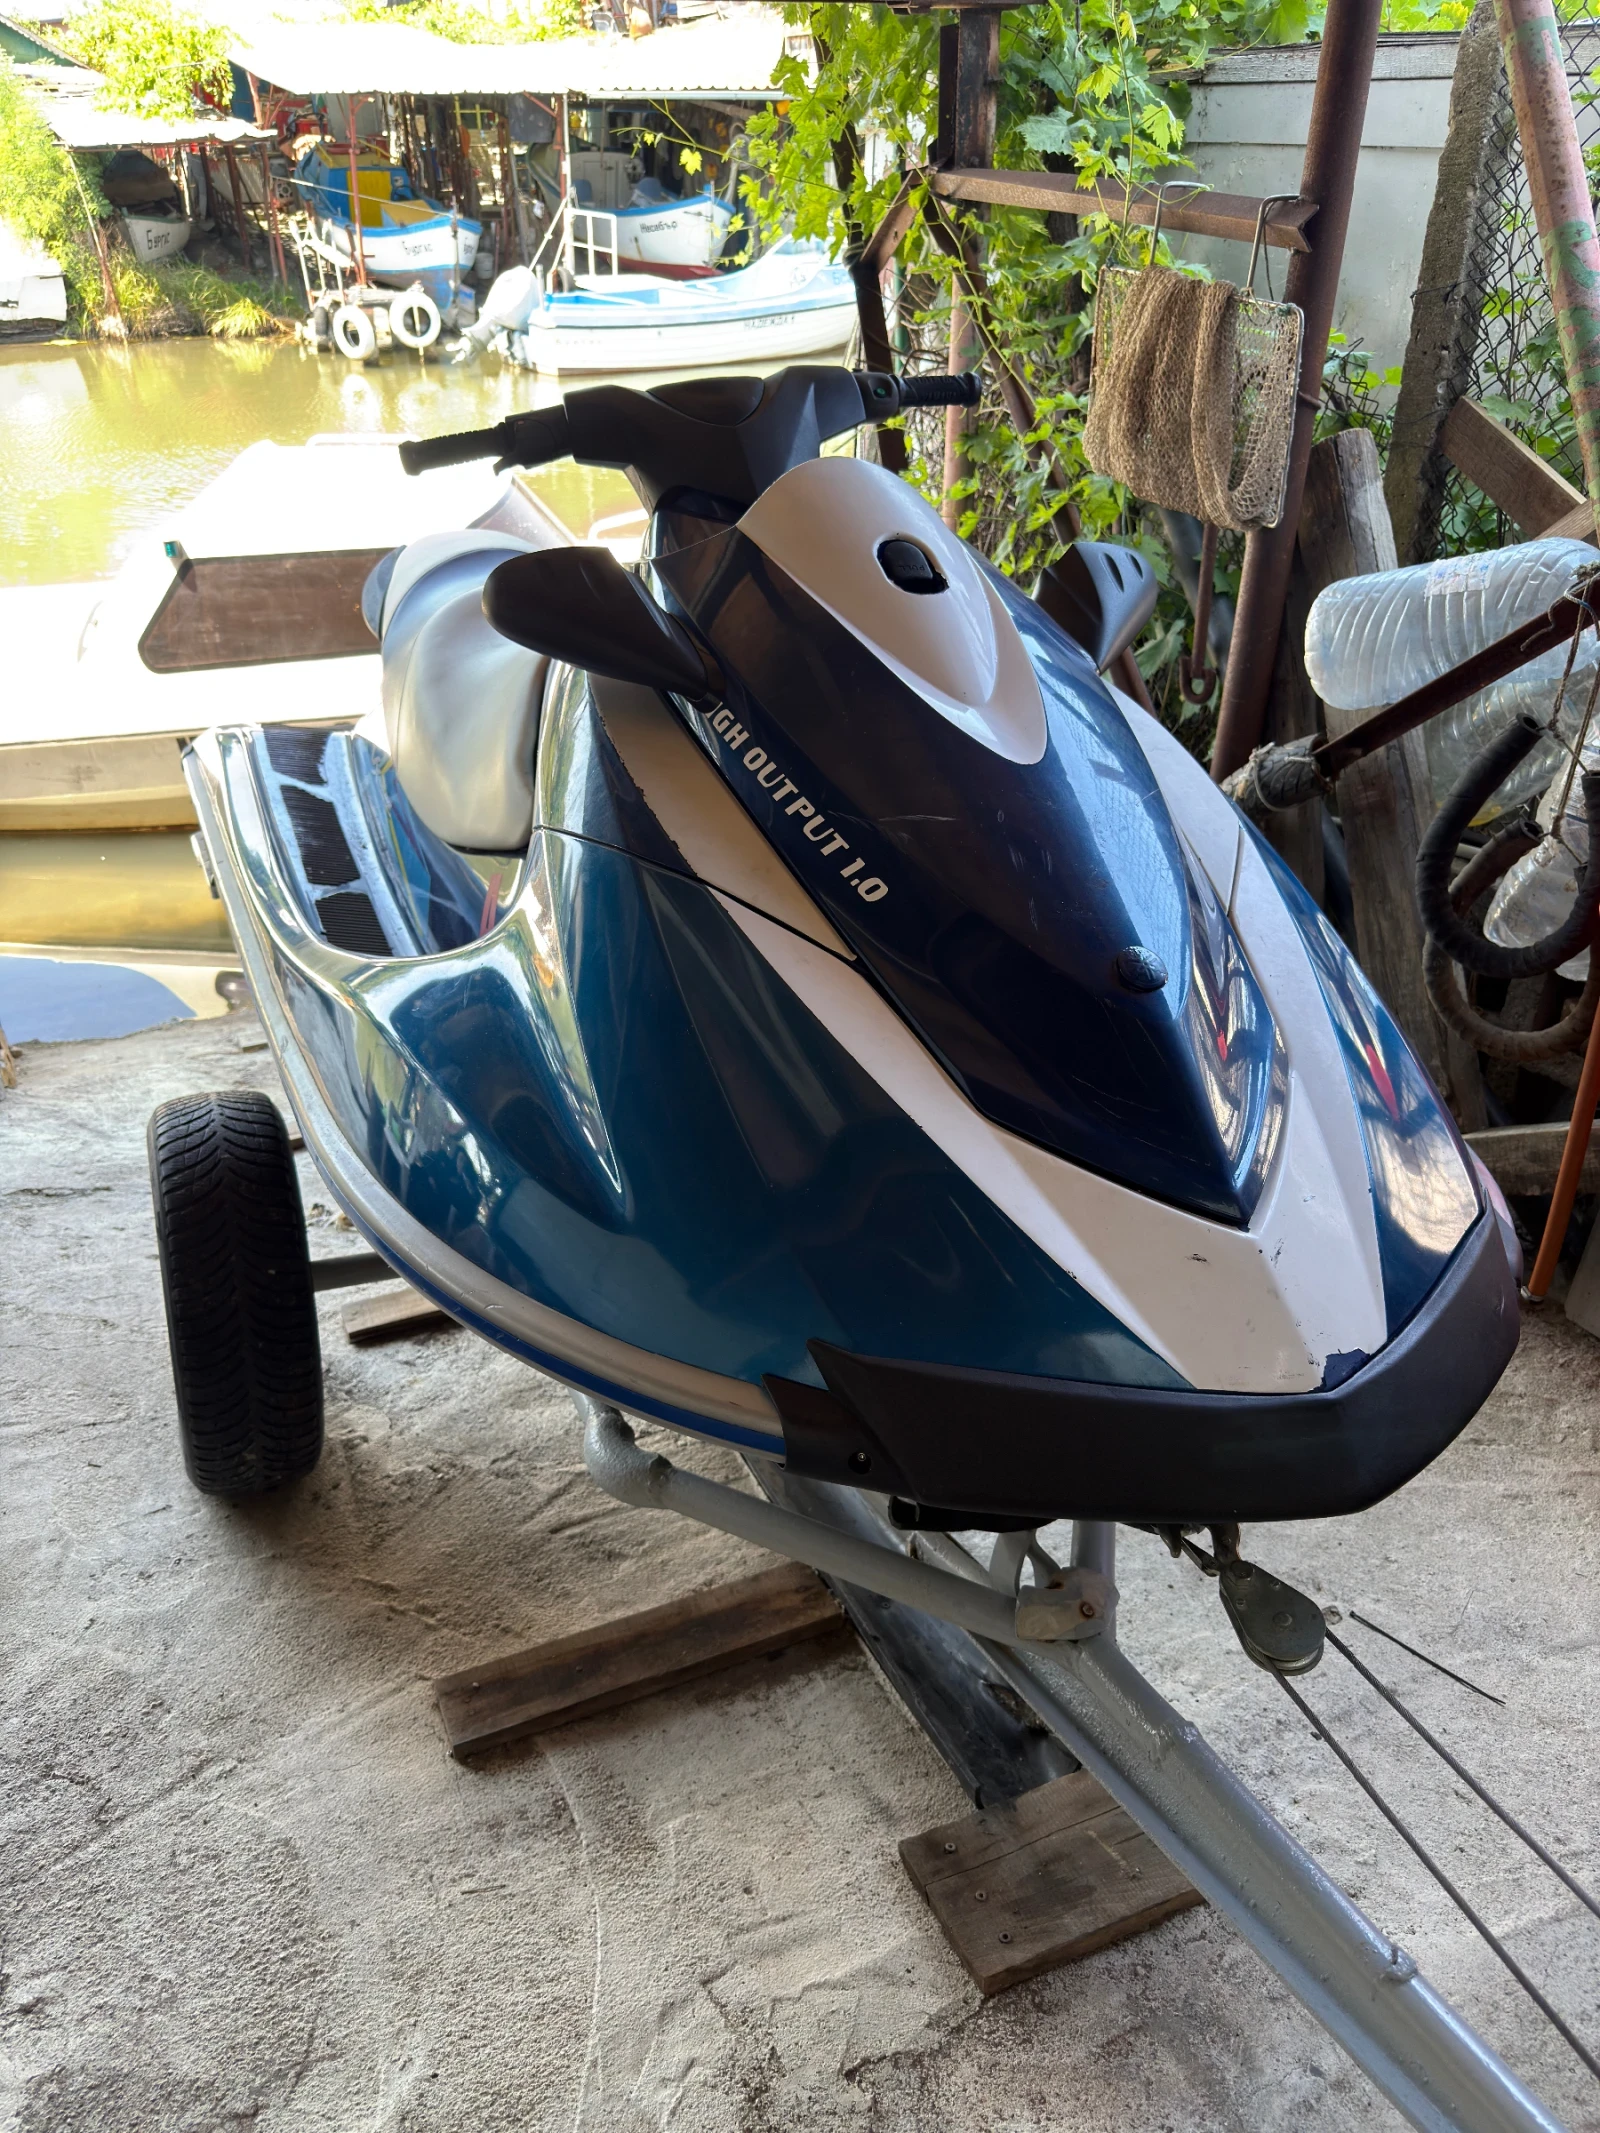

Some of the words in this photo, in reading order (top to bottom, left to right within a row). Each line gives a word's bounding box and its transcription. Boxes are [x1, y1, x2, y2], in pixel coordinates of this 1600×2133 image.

[899, 564, 926, 572] PULL
[705, 701, 750, 750] GH
[743, 747, 850, 856] OUTPUT
[840, 857, 889, 902] 1.0
